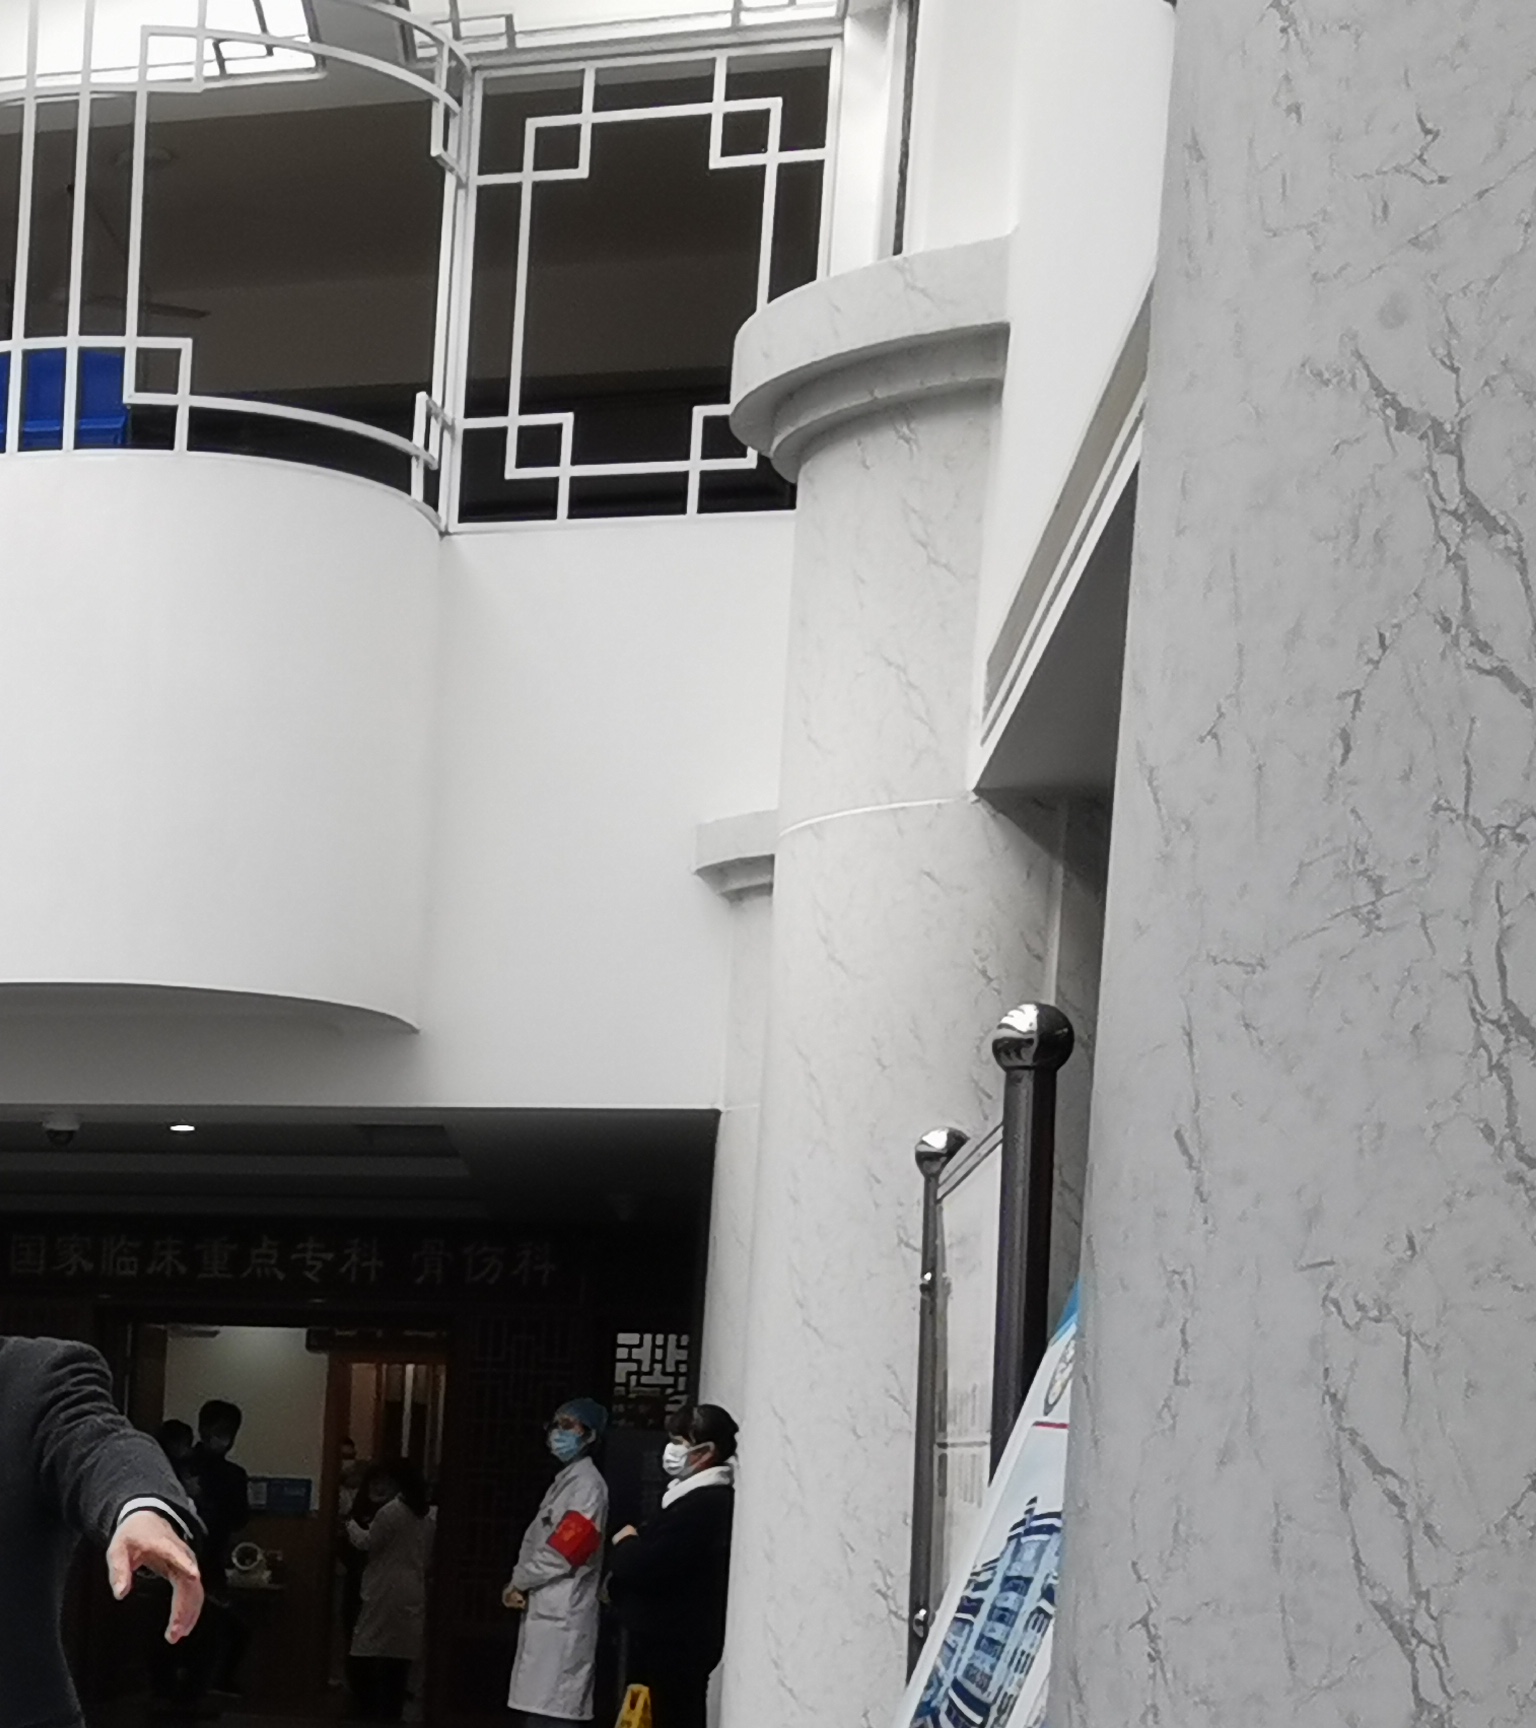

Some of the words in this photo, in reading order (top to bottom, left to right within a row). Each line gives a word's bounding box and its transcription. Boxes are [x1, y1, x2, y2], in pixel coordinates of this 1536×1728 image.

[9, 1233, 384, 1284] 国家临床重点专科
[412, 1238, 557, 1286] 骨伤科
